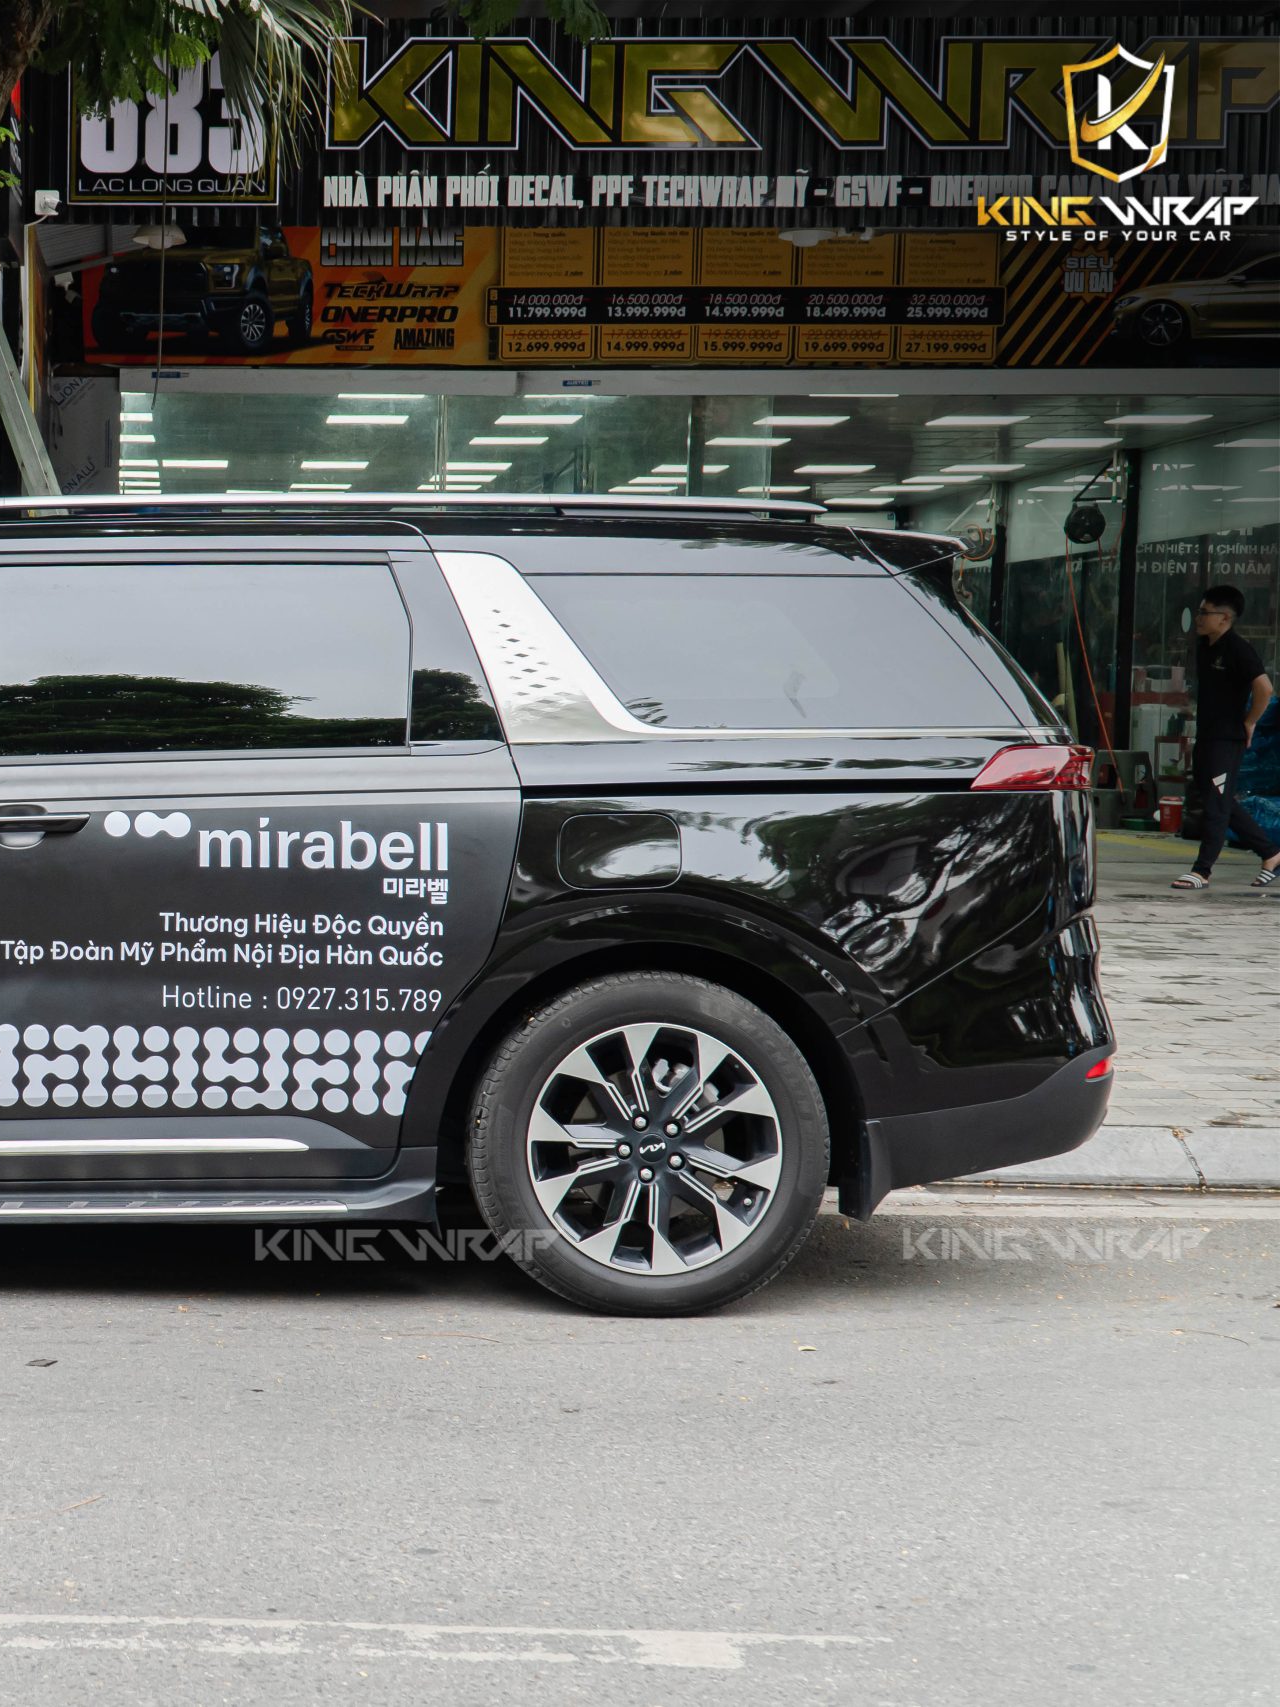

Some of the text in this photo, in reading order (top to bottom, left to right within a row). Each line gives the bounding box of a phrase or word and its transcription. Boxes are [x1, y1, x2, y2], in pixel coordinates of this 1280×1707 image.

[130, 178, 193, 193] LONG
[197, 177, 266, 193] QUÂN
[323, 169, 369, 207] NHÀ
[377, 169, 438, 207] PHÂN
[507, 174, 584, 209] DECAL,
[591, 174, 634, 207] PPF
[642, 175, 769, 207] TECHWRAP
[835, 175, 903, 207] GSWF
[321, 306, 458, 322] ONERPRO
[394, 328, 455, 349] AMAZING
[1234, 560, 1271, 574] NĂM
[198, 817, 448, 871] mirabell
[382, 878, 448, 905] 미라벨
[159, 912, 444, 940] Thương Hiệu Độc Quyền
[0, 939, 44, 965] Tập
[50, 940, 114, 961] Đoàn
[120, 941, 154, 966] Mỹ
[160, 938, 227, 963] Phẩm
[233, 943, 272, 968] Nội
[279, 943, 320, 969] Địa
[326, 944, 373, 965] Hàn
[379, 942, 444, 966] Quốc
[162, 985, 252, 1009] Hotline
[277, 986, 442, 1012] 0927.315.789
